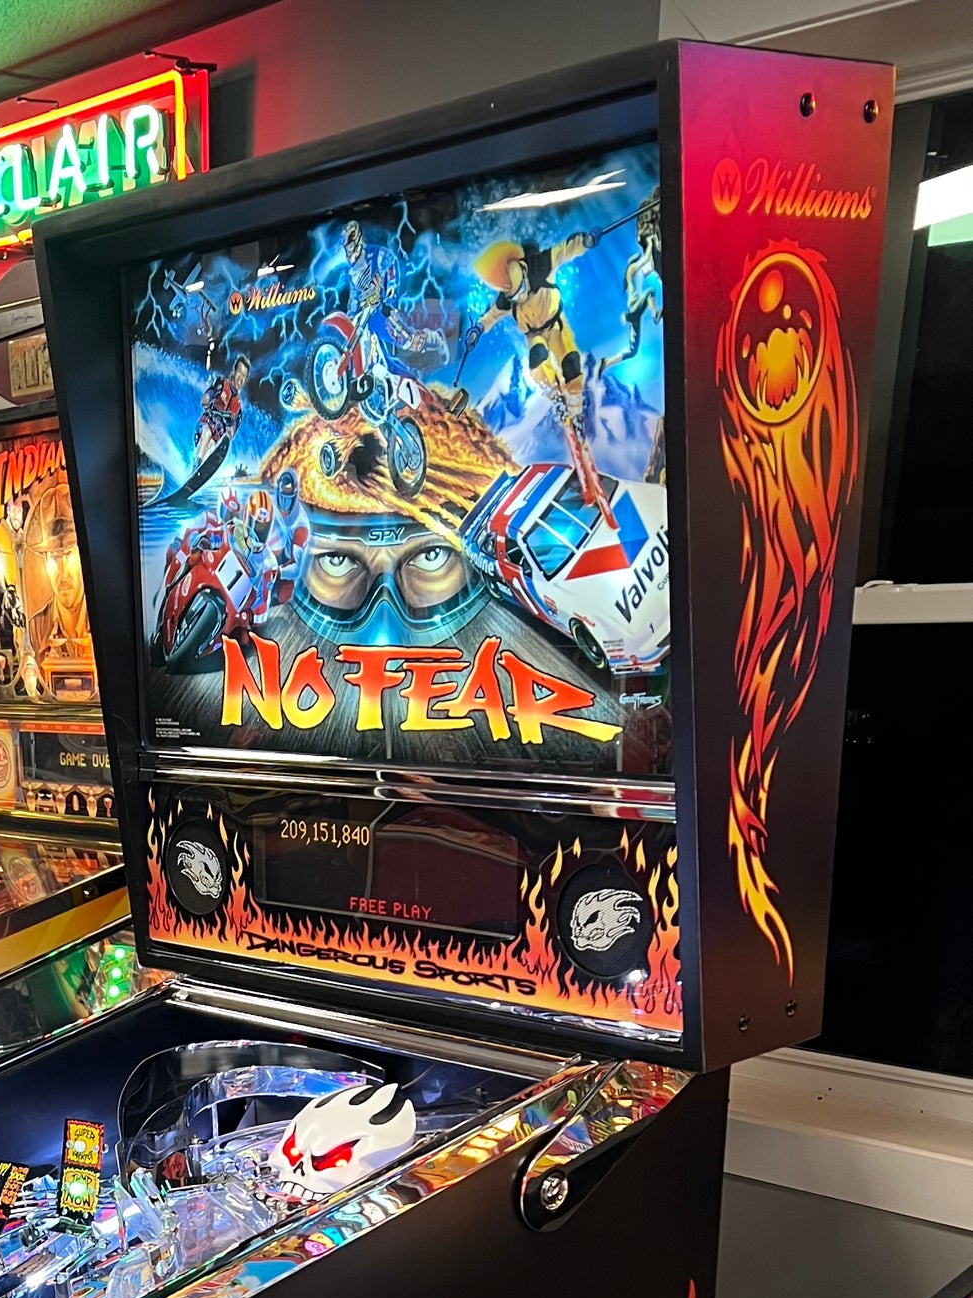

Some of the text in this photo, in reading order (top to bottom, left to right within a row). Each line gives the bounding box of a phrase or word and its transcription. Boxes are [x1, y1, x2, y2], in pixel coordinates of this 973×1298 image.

[745, 157, 872, 219] Williams
[246, 282, 316, 311] Williams
[368, 527, 406, 542] SPY
[221, 631, 624, 745] NO FEAR
[59, 752, 111, 768] GAME OVE
[280, 819, 370, 846] 209,151,840
[349, 896, 433, 921] FREE PLAY
[241, 929, 537, 997] DANGEROUS SPORTS
[74, 1129, 96, 1142] SUPER
